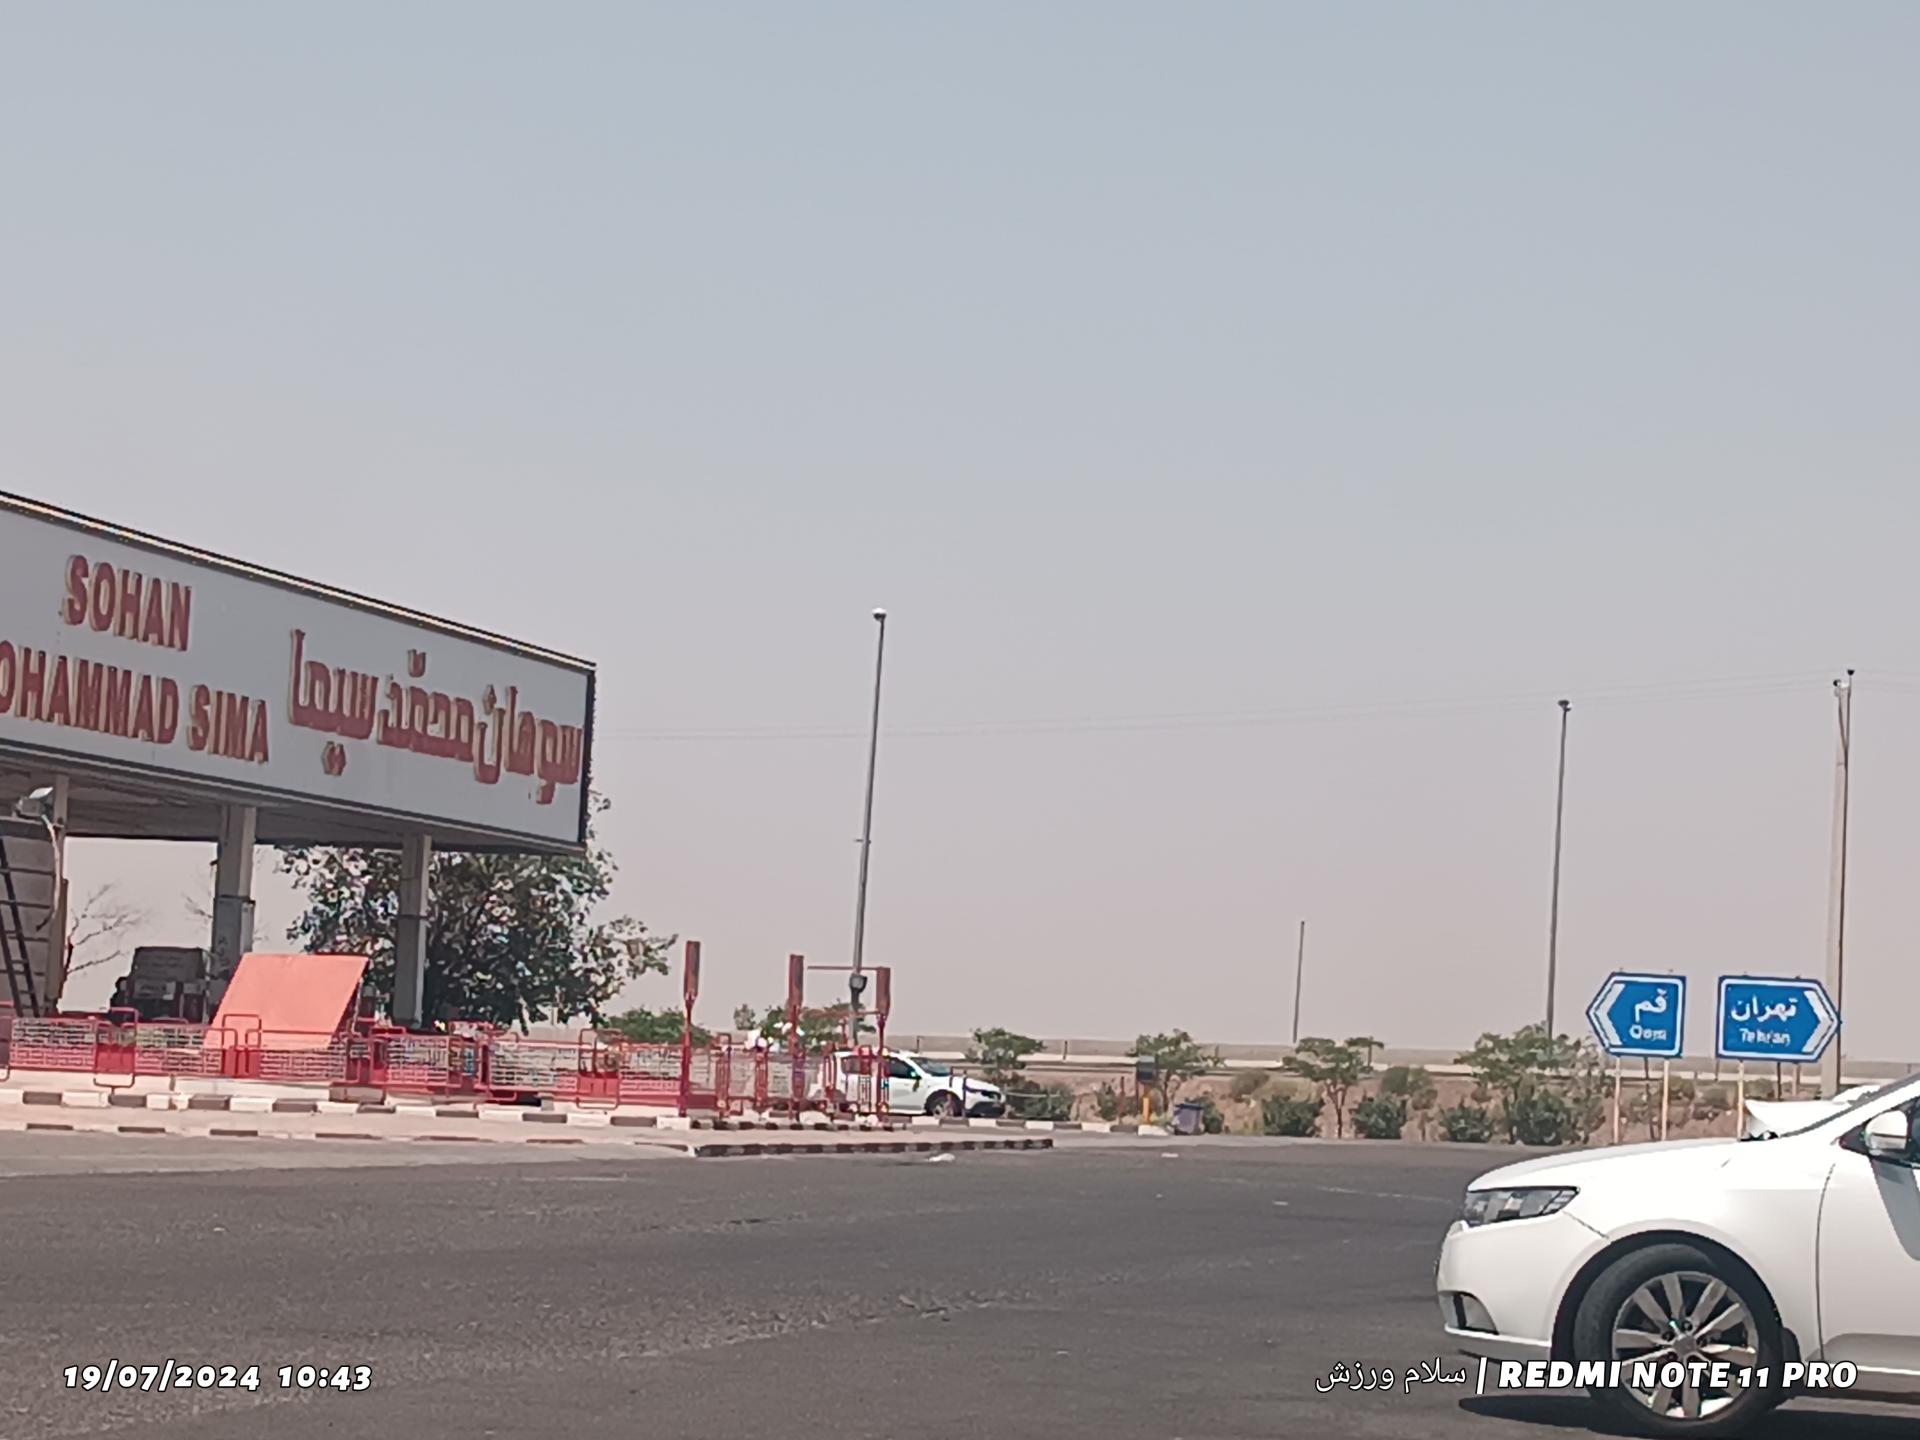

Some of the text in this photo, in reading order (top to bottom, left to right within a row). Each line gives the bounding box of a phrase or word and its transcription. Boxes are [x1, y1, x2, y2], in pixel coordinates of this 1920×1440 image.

[63, 554, 193, 652] SOHAN
[187, 684, 269, 765] SIMA
[475, 684, 583, 805] سوهان
[1634, 987, 1668, 1023] قم
[1730, 993, 1799, 1023] تهران
[1739, 1027, 1791, 1047] Tehran
